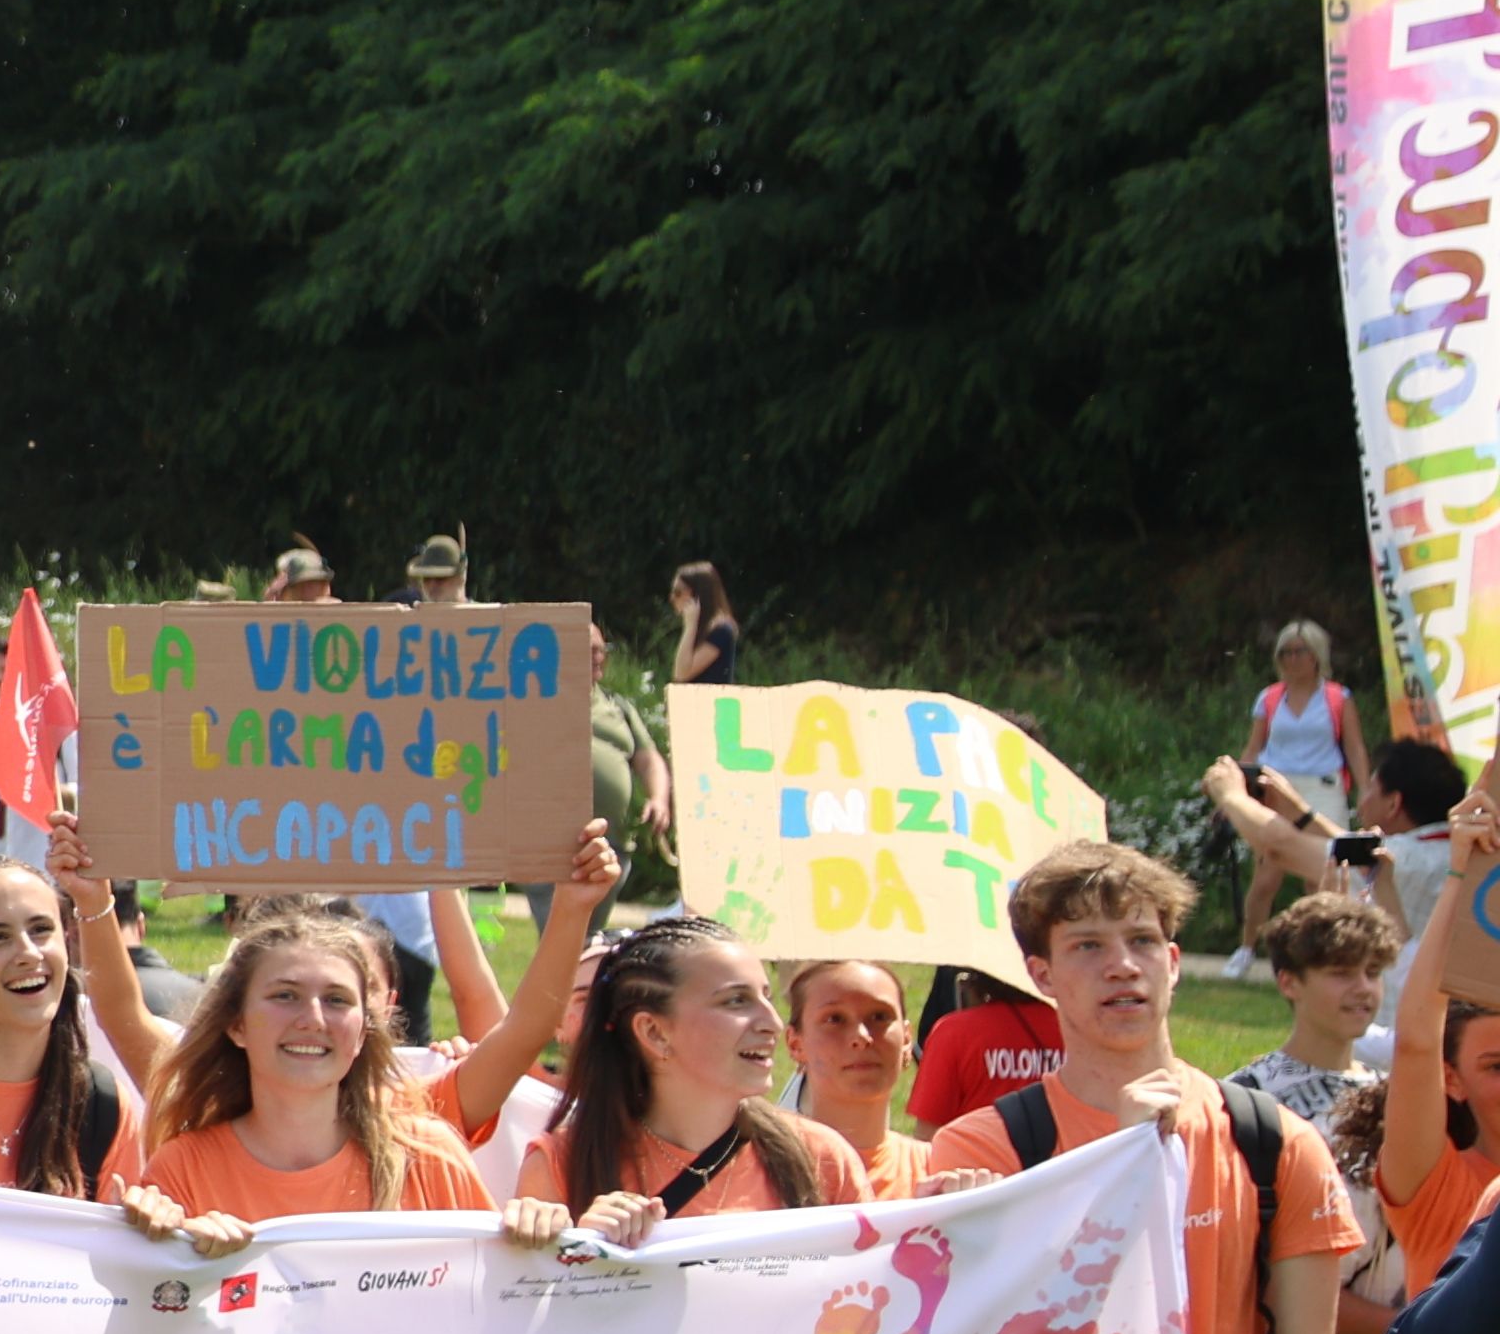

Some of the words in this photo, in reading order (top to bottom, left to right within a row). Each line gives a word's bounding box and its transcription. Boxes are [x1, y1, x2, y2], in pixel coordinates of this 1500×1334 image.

[106, 624, 197, 695] LA
[244, 620, 560, 701] VIOLENZA
[111, 712, 144, 770] è
[190, 705, 385, 773] L'ARMA
[402, 707, 510, 814] degli
[714, 695, 861, 778] LA
[905, 701, 1058, 830] PACE
[779, 787, 1015, 863] INIZIA
[808, 848, 926, 934] DA
[944, 849, 1019, 928] T
[71, 1295, 129, 1308] europea
